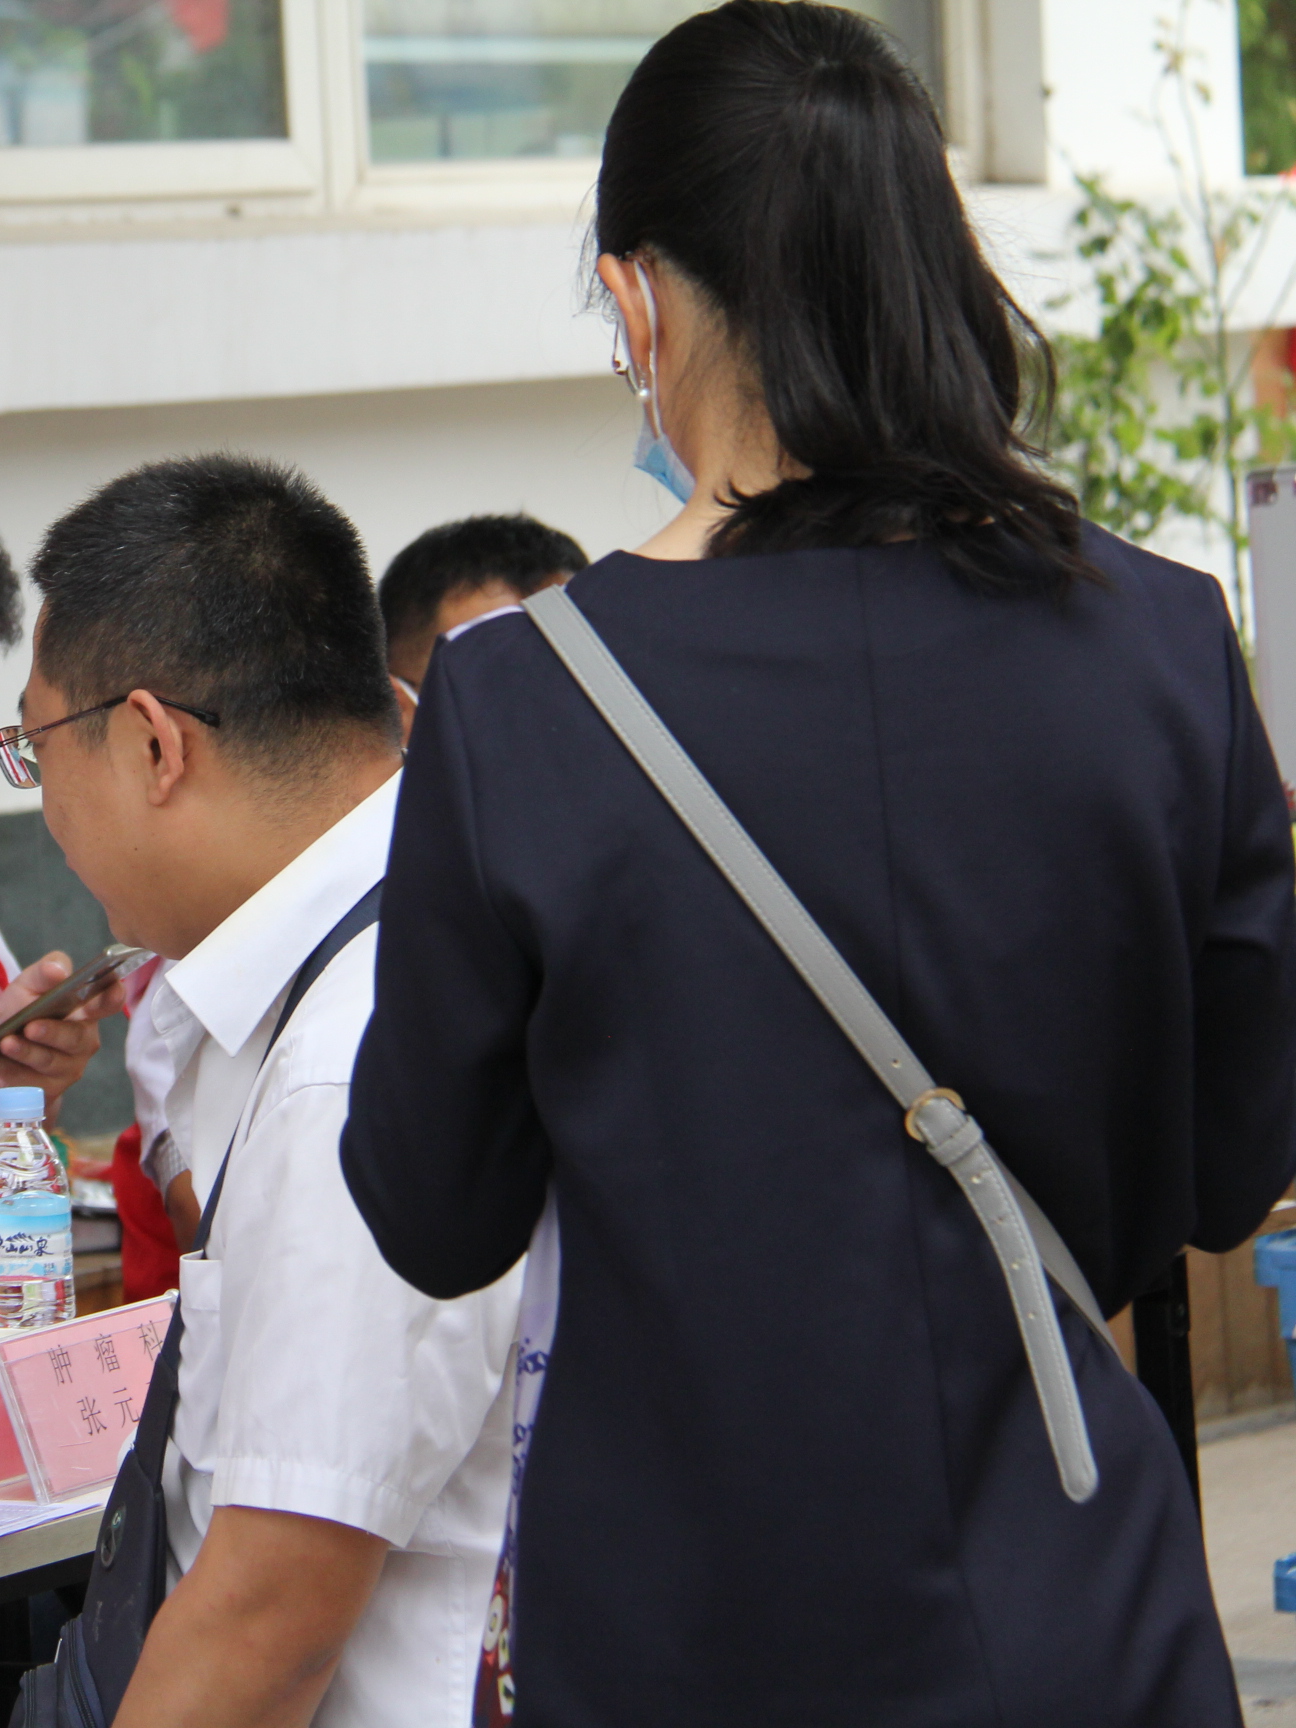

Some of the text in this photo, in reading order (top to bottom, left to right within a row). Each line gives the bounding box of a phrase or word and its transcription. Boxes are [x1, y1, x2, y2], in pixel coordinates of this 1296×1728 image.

[47, 1319, 163, 1385] 肿瘤科
[77, 1381, 151, 1436] 张元
